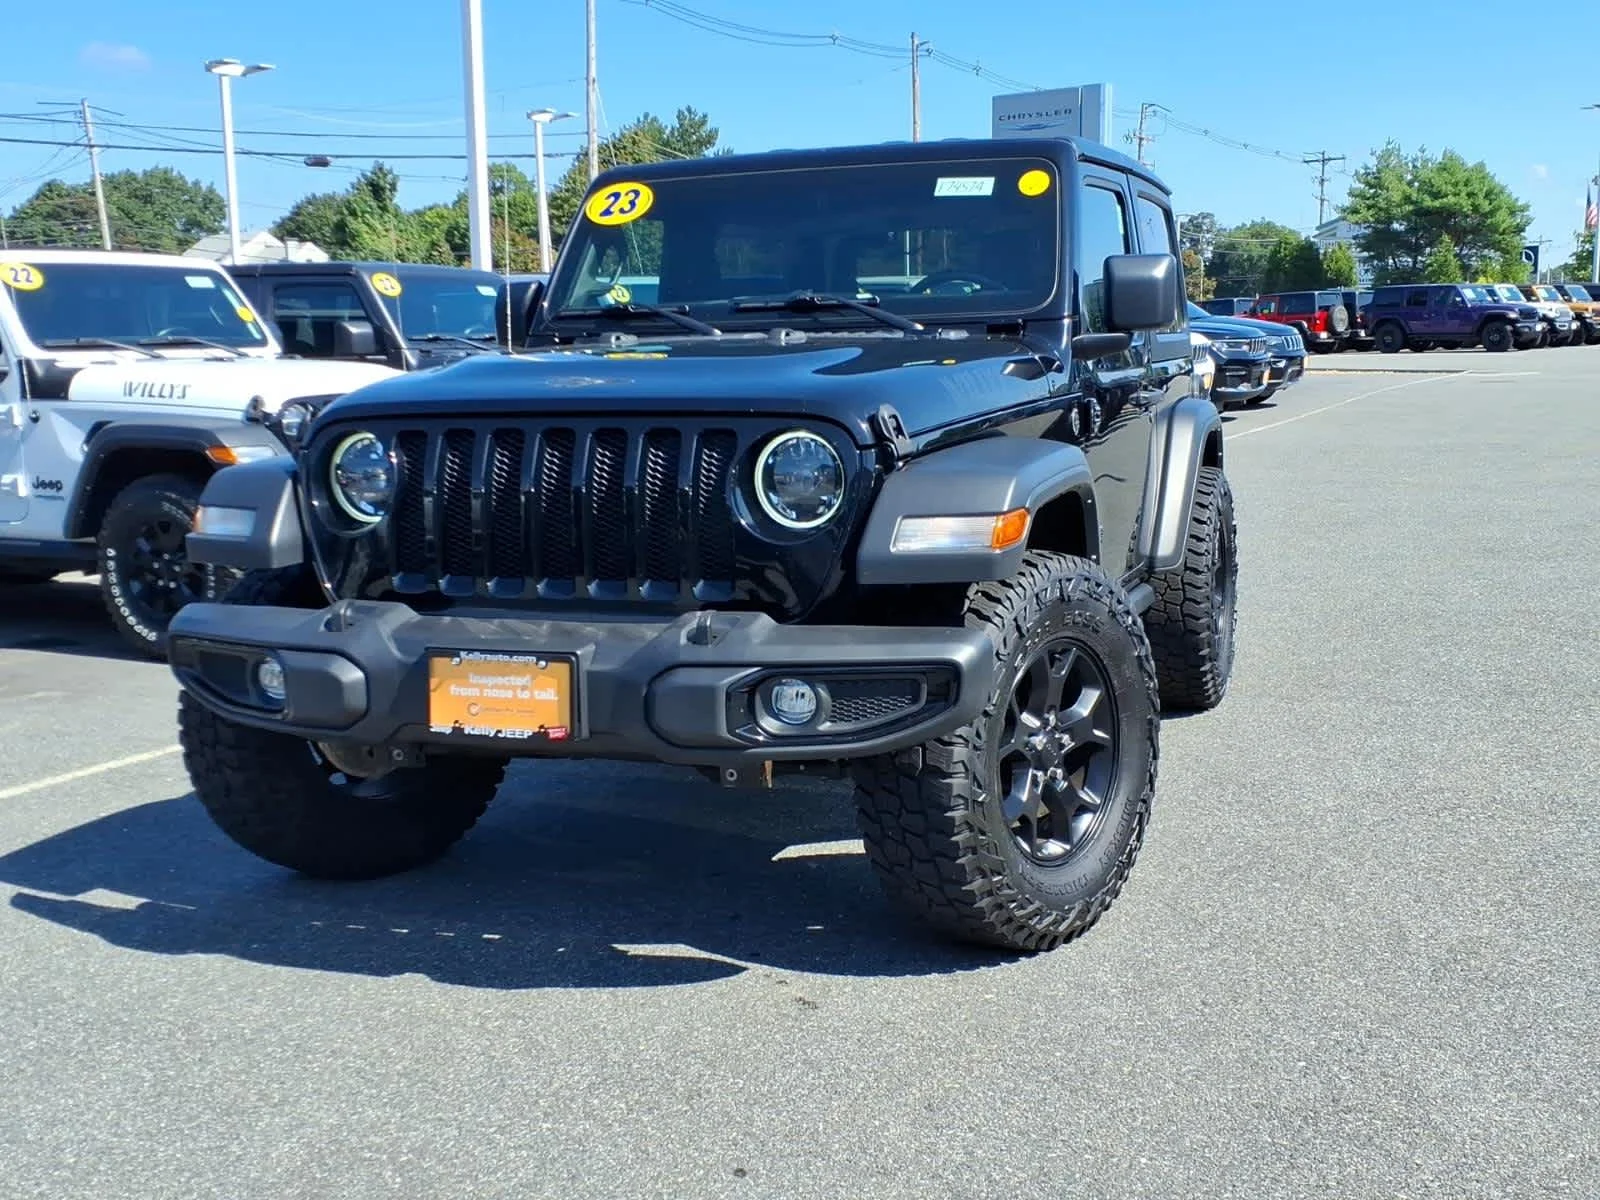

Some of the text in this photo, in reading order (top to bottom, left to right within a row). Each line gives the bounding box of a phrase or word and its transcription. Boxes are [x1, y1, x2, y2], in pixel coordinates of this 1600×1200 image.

[998, 108, 1072, 121] CHRYSLER
[599, 189, 641, 217] 23
[10, 267, 34, 284] 22
[123, 380, 193, 400] WILLYS
[32, 475, 64, 493] Jeep
[469, 673, 532, 687] Inspected
[451, 685, 480, 697] from
[483, 687, 513, 699] nose
[517, 686, 531, 699] to
[498, 728, 533, 739] JEEP
